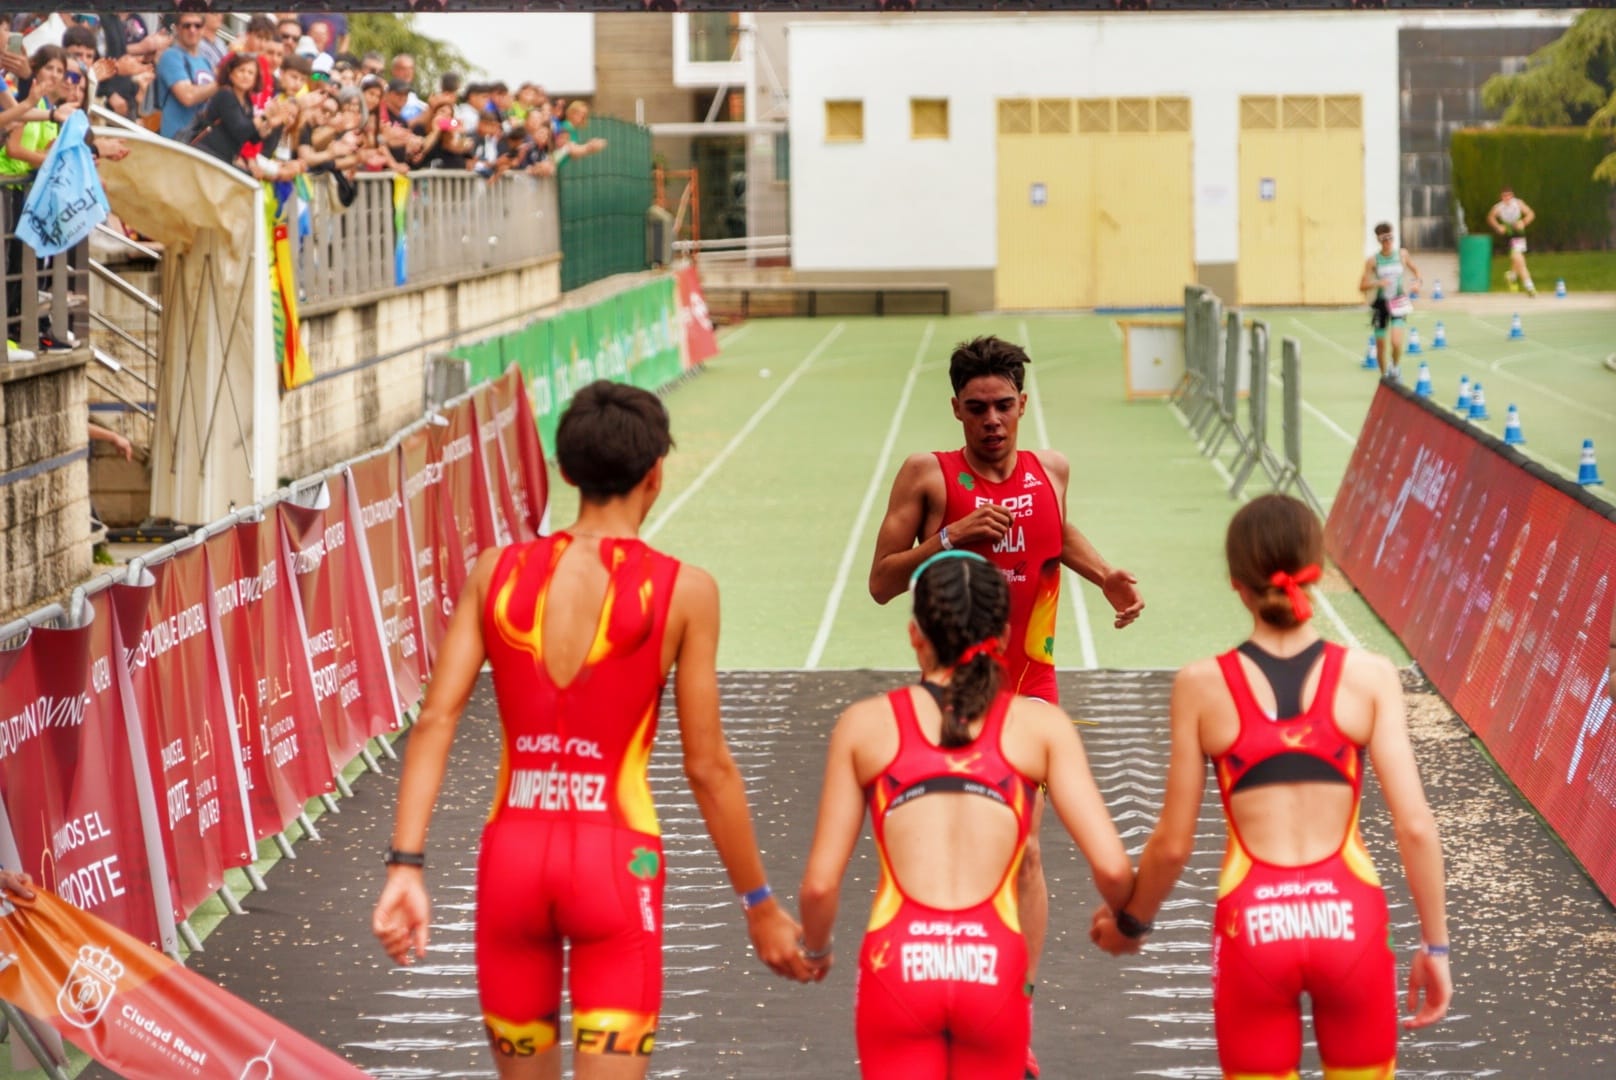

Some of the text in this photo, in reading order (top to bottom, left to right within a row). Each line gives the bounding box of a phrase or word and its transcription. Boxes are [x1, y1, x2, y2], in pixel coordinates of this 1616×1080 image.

[516, 733, 603, 760] austral
[508, 762, 607, 812] UMPIÉRREZ
[84, 810, 111, 841] EL
[1255, 880, 1340, 900] austral
[909, 920, 989, 937] austral
[1245, 901, 1356, 947] FERNANDE
[901, 937, 998, 986] FERNÁNDEZ
[115, 1017, 201, 1077] AYUNTAMIENTO
[121, 1004, 207, 1067] Ciudad Real
